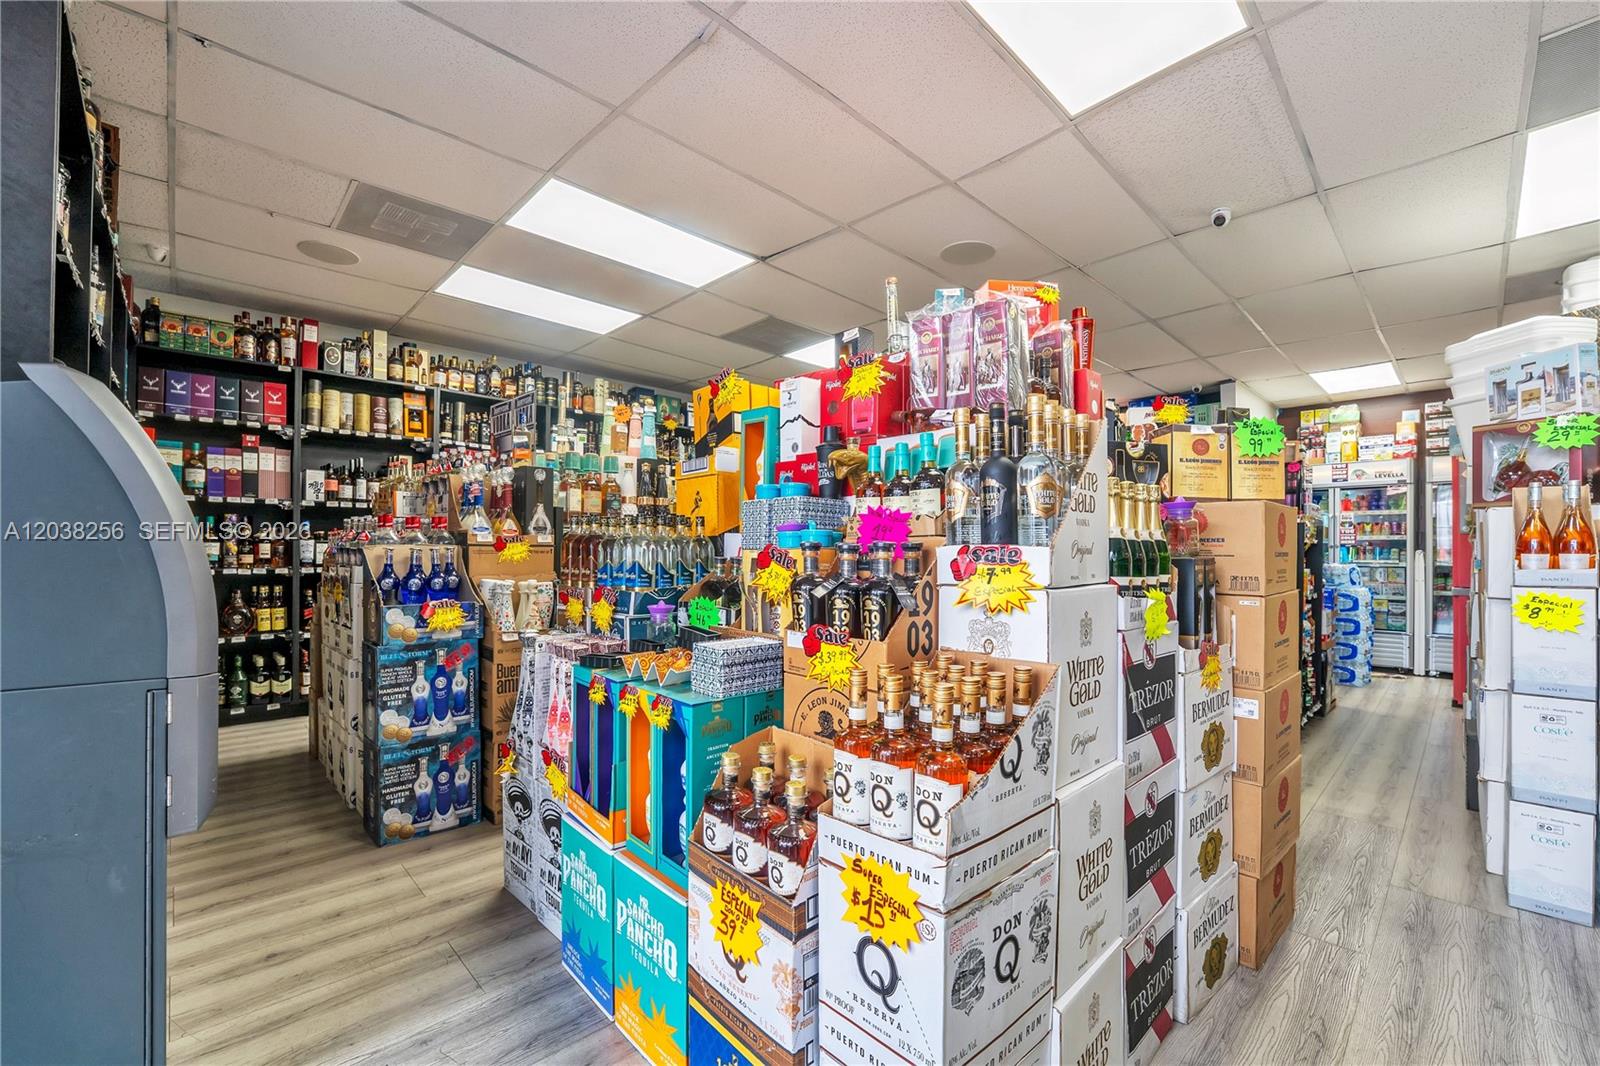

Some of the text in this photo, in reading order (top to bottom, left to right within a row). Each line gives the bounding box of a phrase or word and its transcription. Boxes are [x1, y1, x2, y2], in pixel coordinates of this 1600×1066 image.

[832, 610, 850, 625] 19
[864, 611, 880, 626] 19
[907, 620, 933, 657] 03
[1066, 655, 1105, 684] WHITE
[379, 686, 410, 694] HANDMADE
[382, 693, 407, 701] GLUTEN
[496, 678, 519, 695] ami
[1146, 713, 1161, 728] BRUT
[1192, 690, 1230, 723] BERMUDEZ
[382, 784, 413, 794] HANDMADE
[834, 771, 851, 804] Q
[870, 772, 894, 786] DON
[916, 786, 943, 801] DON
[385, 791, 410, 800] GLUTEN
[871, 784, 894, 818] Q
[704, 819, 717, 828] DON
[916, 800, 941, 836] Q
[1189, 794, 1229, 838] BERMUDEZ
[704, 826, 717, 846] Q
[735, 837, 749, 848] DON
[1129, 820, 1174, 870] TRÉZOR
[510, 861, 527, 881] TEQUILA
[570, 852, 598, 887] SANCHO
[735, 845, 748, 868] Q
[769, 857, 784, 868] DON
[830, 834, 866, 858] PUERTO
[906, 866, 931, 885] RUM
[963, 830, 1044, 883] PUERTO RICAN RUM
[1076, 838, 1113, 880] WHITE
[1145, 858, 1161, 880] BRUT
[563, 853, 607, 921] PANCHO
[770, 865, 784, 889] Q
[851, 858, 883, 886] SUPER
[573, 894, 594, 919] TEQUILA
[721, 887, 755, 922] ESPECIAL
[870, 884, 911, 919] ESPECIAL
[626, 897, 664, 939] SANCHO
[717, 910, 737, 940] 39
[992, 912, 1022, 943] DON
[1193, 895, 1235, 949] BERMUDEZ
[616, 898, 678, 981] PANCHO
[630, 949, 659, 978] TEQUILA
[994, 934, 1021, 984] Q
[854, 936, 901, 1015] Q
[1129, 957, 1174, 1023] TRÉZOR
[991, 982, 1022, 1010] RESERVA
[852, 995, 903, 1032] RESERVA
[830, 1026, 865, 1058] PUERTO
[998, 1015, 1043, 1060] RICAN RUM
